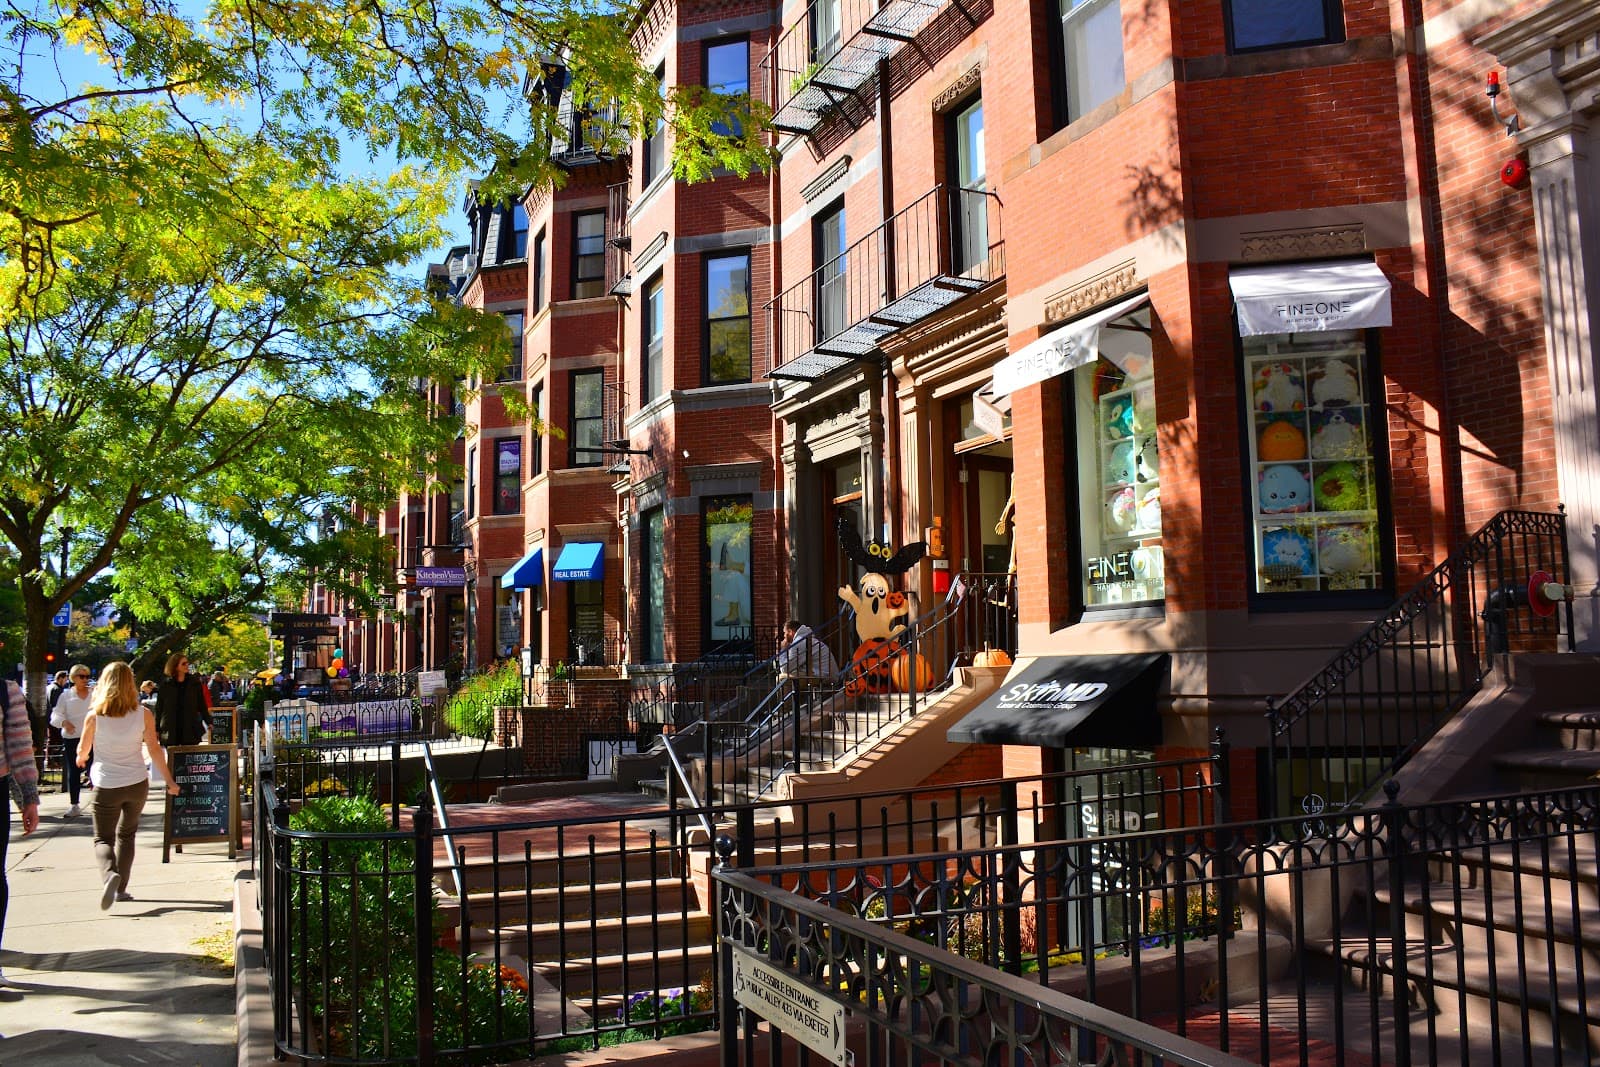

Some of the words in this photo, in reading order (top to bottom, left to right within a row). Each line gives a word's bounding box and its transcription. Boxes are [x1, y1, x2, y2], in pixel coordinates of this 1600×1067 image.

[1277, 301, 1352, 316] FINEONE
[1016, 338, 1073, 375] FINEONE
[415, 570, 465, 579] KitchenWares
[555, 570, 570, 578] REAL
[1000, 680, 1108, 702] SkinMD
[1053, 703, 1077, 711] Group
[187, 765, 216, 773] WELCOME
[753, 967, 785, 994] ACCESSIBLE
[786, 983, 820, 1014] ENTRANCE
[746, 980, 764, 999] PUBLIC
[765, 994, 781, 1009] ALLEY
[782, 1002, 793, 1017] 433
[793, 1009, 804, 1024] VIA
[805, 1014, 829, 1039] EXETER
